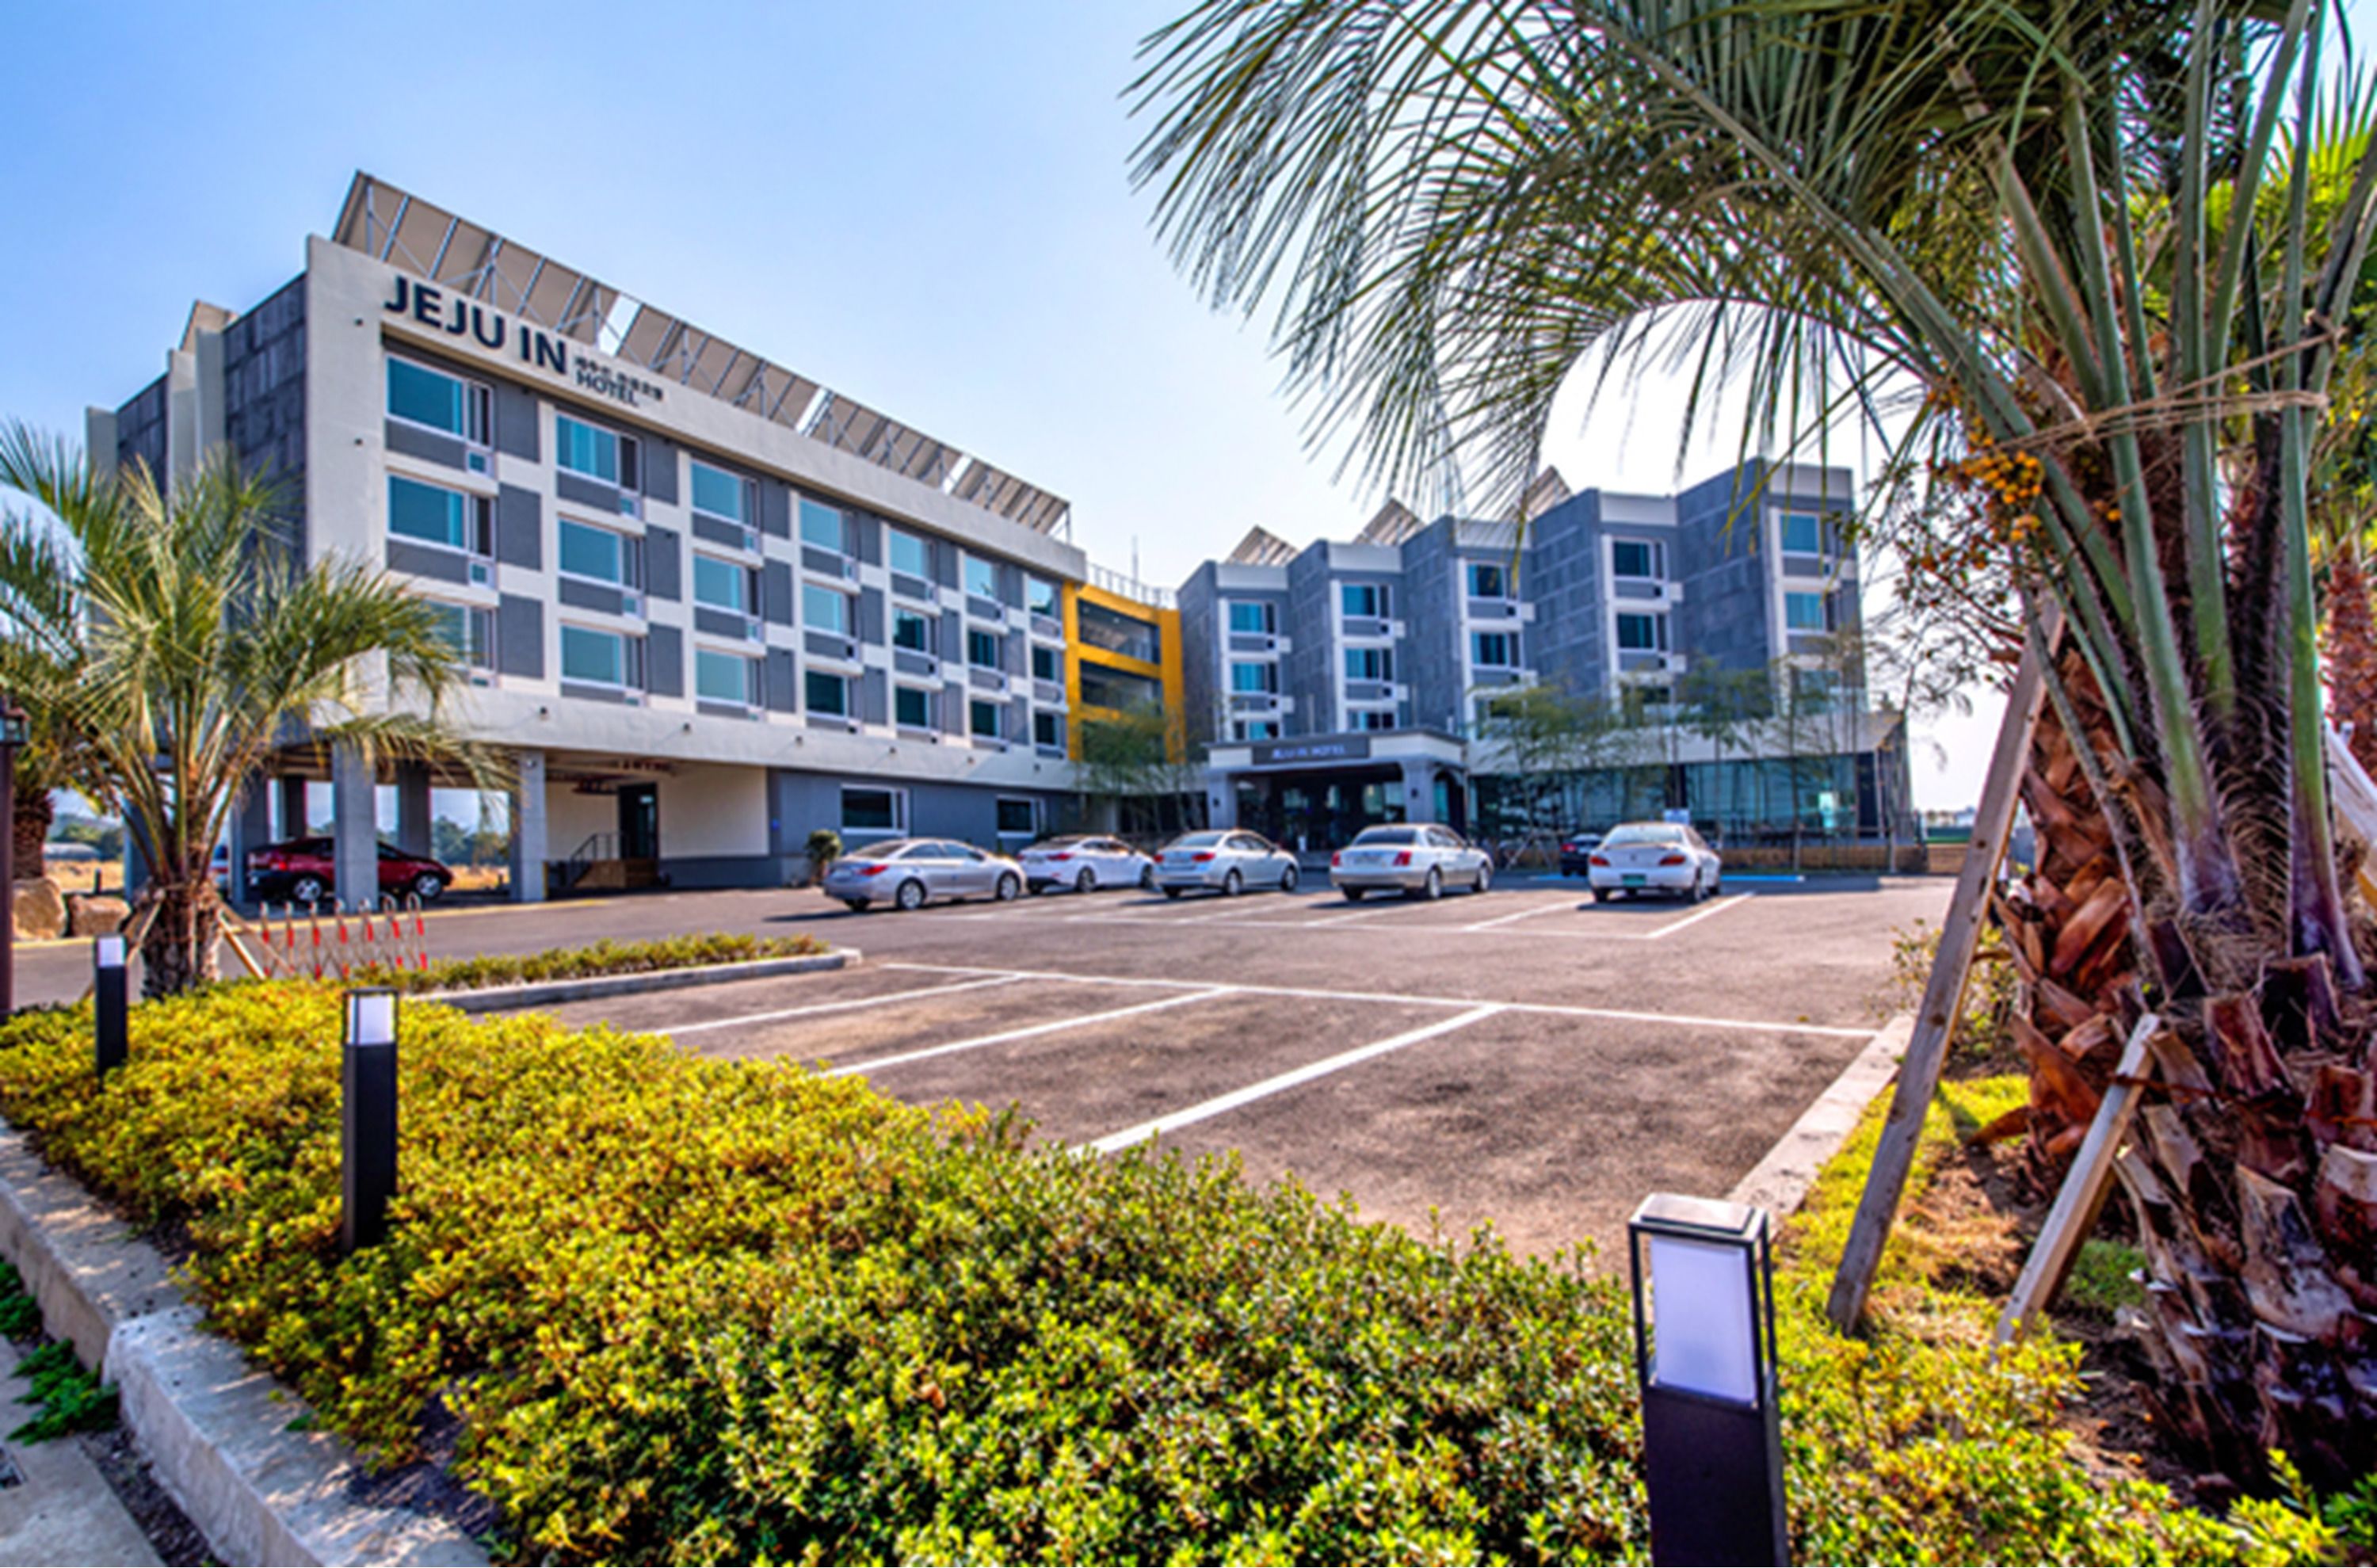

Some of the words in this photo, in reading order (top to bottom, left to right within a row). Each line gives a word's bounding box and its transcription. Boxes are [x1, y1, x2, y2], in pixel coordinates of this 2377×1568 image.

[384, 275, 506, 349] JEJU
[520, 325, 567, 375] IN
[575, 368, 639, 407] HOTEL
